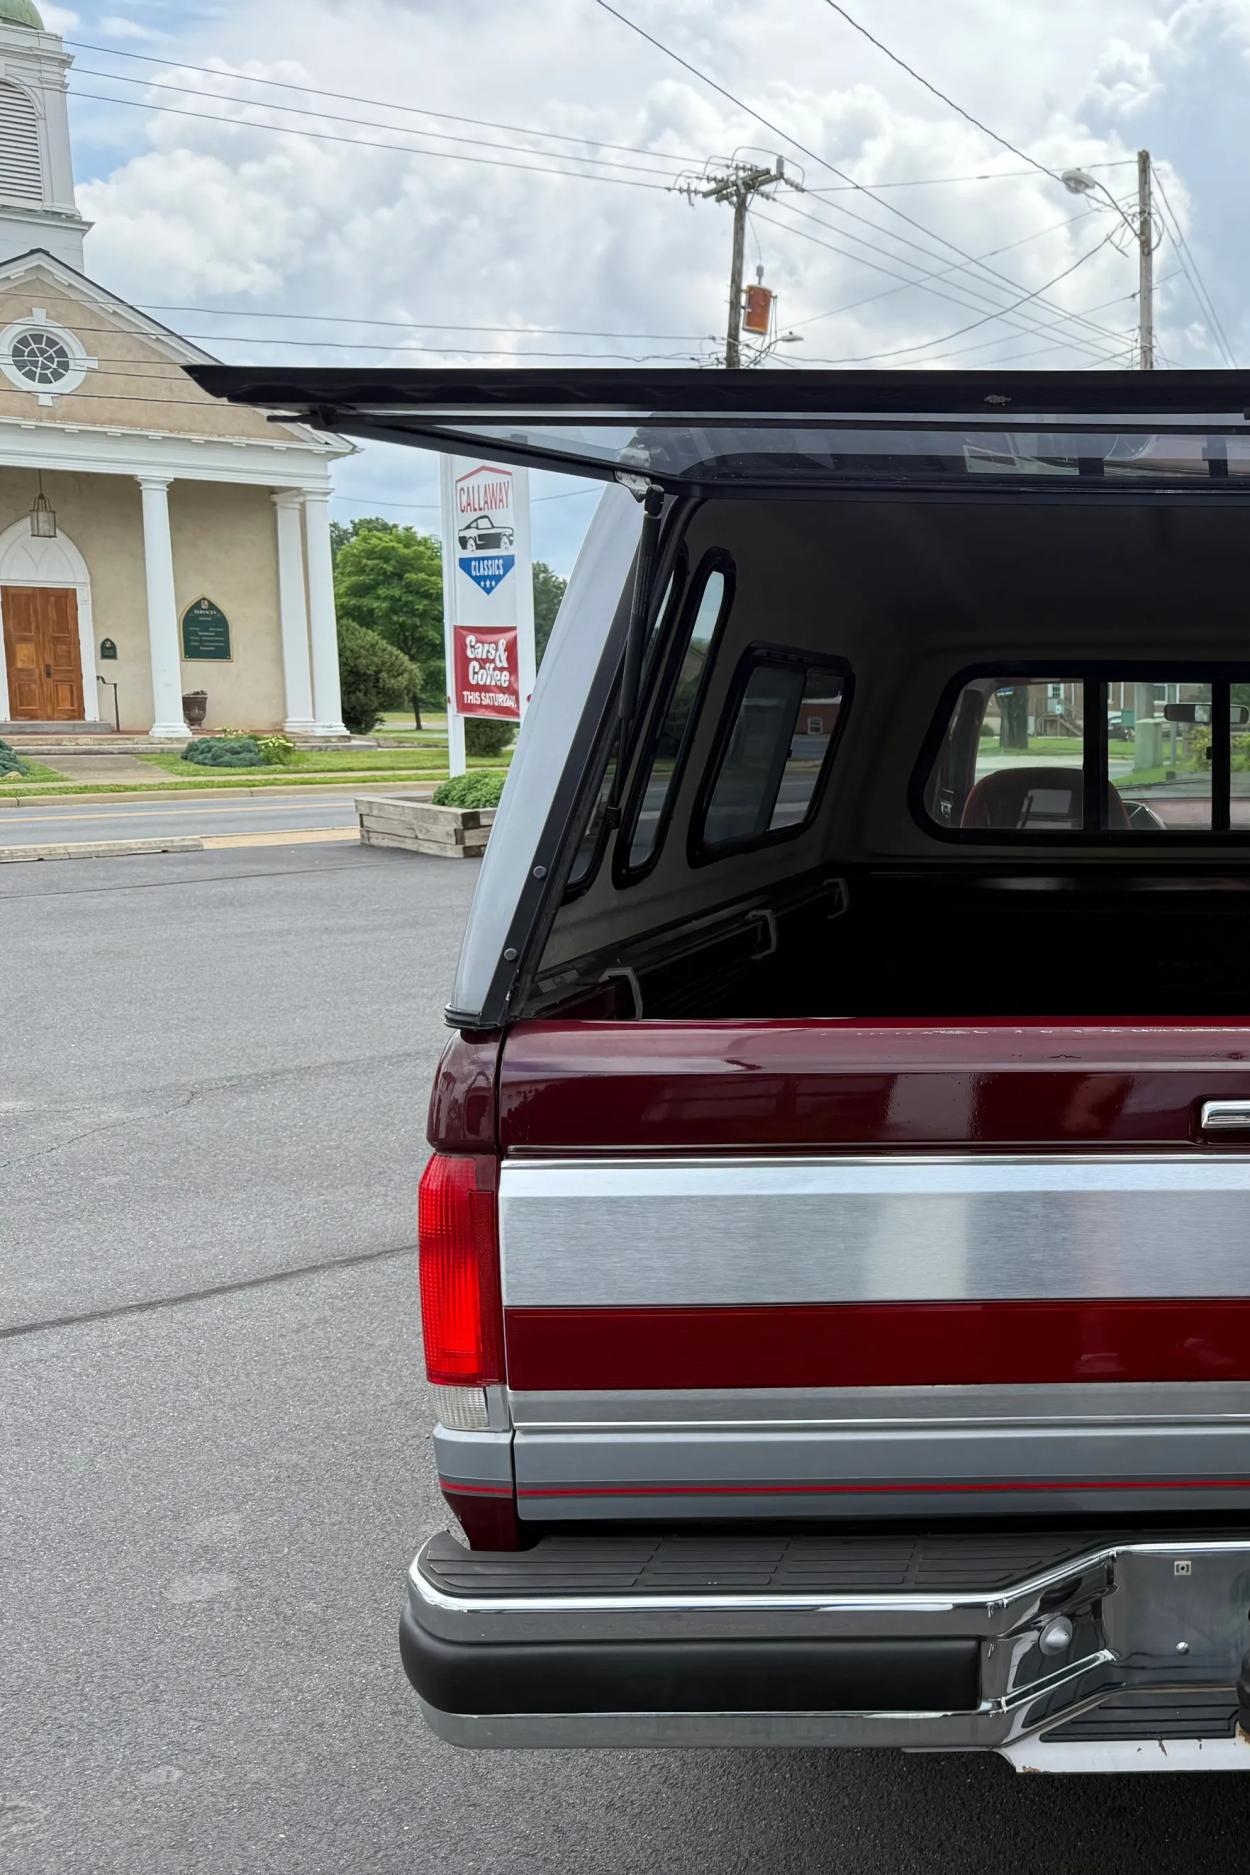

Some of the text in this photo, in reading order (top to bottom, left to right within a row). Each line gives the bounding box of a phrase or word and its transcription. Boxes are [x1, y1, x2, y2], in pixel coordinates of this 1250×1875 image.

[459, 481, 509, 513] CALLAWAY
[471, 559, 503, 576] CLASSICS
[466, 635, 509, 668] Cars &
[469, 661, 510, 687] Coffee
[463, 691, 481, 705] THIS
